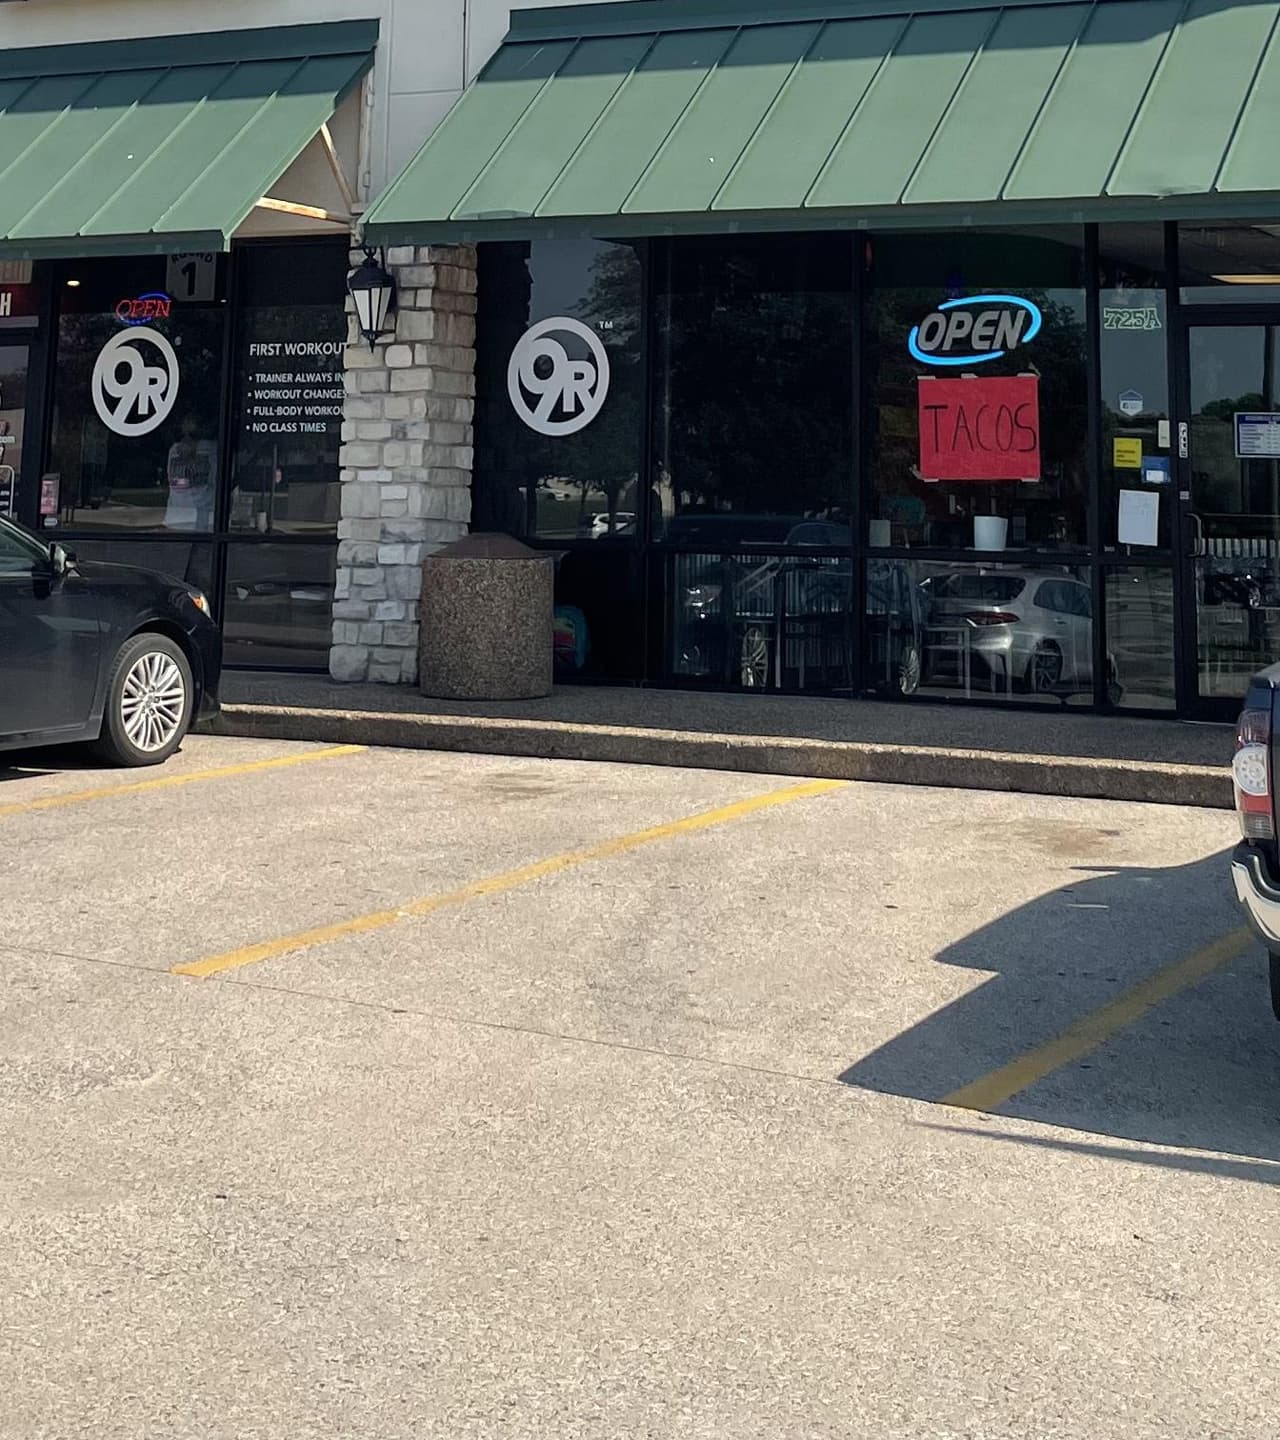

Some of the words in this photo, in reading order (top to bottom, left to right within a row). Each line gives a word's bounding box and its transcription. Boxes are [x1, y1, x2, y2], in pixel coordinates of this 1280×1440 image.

[180, 261, 197, 297] 1
[0, 292, 12, 316] H
[115, 299, 172, 318] OPEN
[1104, 308, 1161, 330] 725A
[918, 310, 1026, 351] OPEN
[249, 343, 282, 356] FIRST
[284, 341, 347, 356] WORKOUT
[255, 373, 293, 383] TRAINER
[295, 372, 333, 383] ALWAYS
[254, 389, 302, 400] WORKOUT
[253, 406, 303, 416] FULL-BODY
[252, 422, 268, 432] NO
[269, 422, 297, 432] CLASS
[299, 422, 327, 433] TIMES
[923, 403, 1037, 453] TACOS
